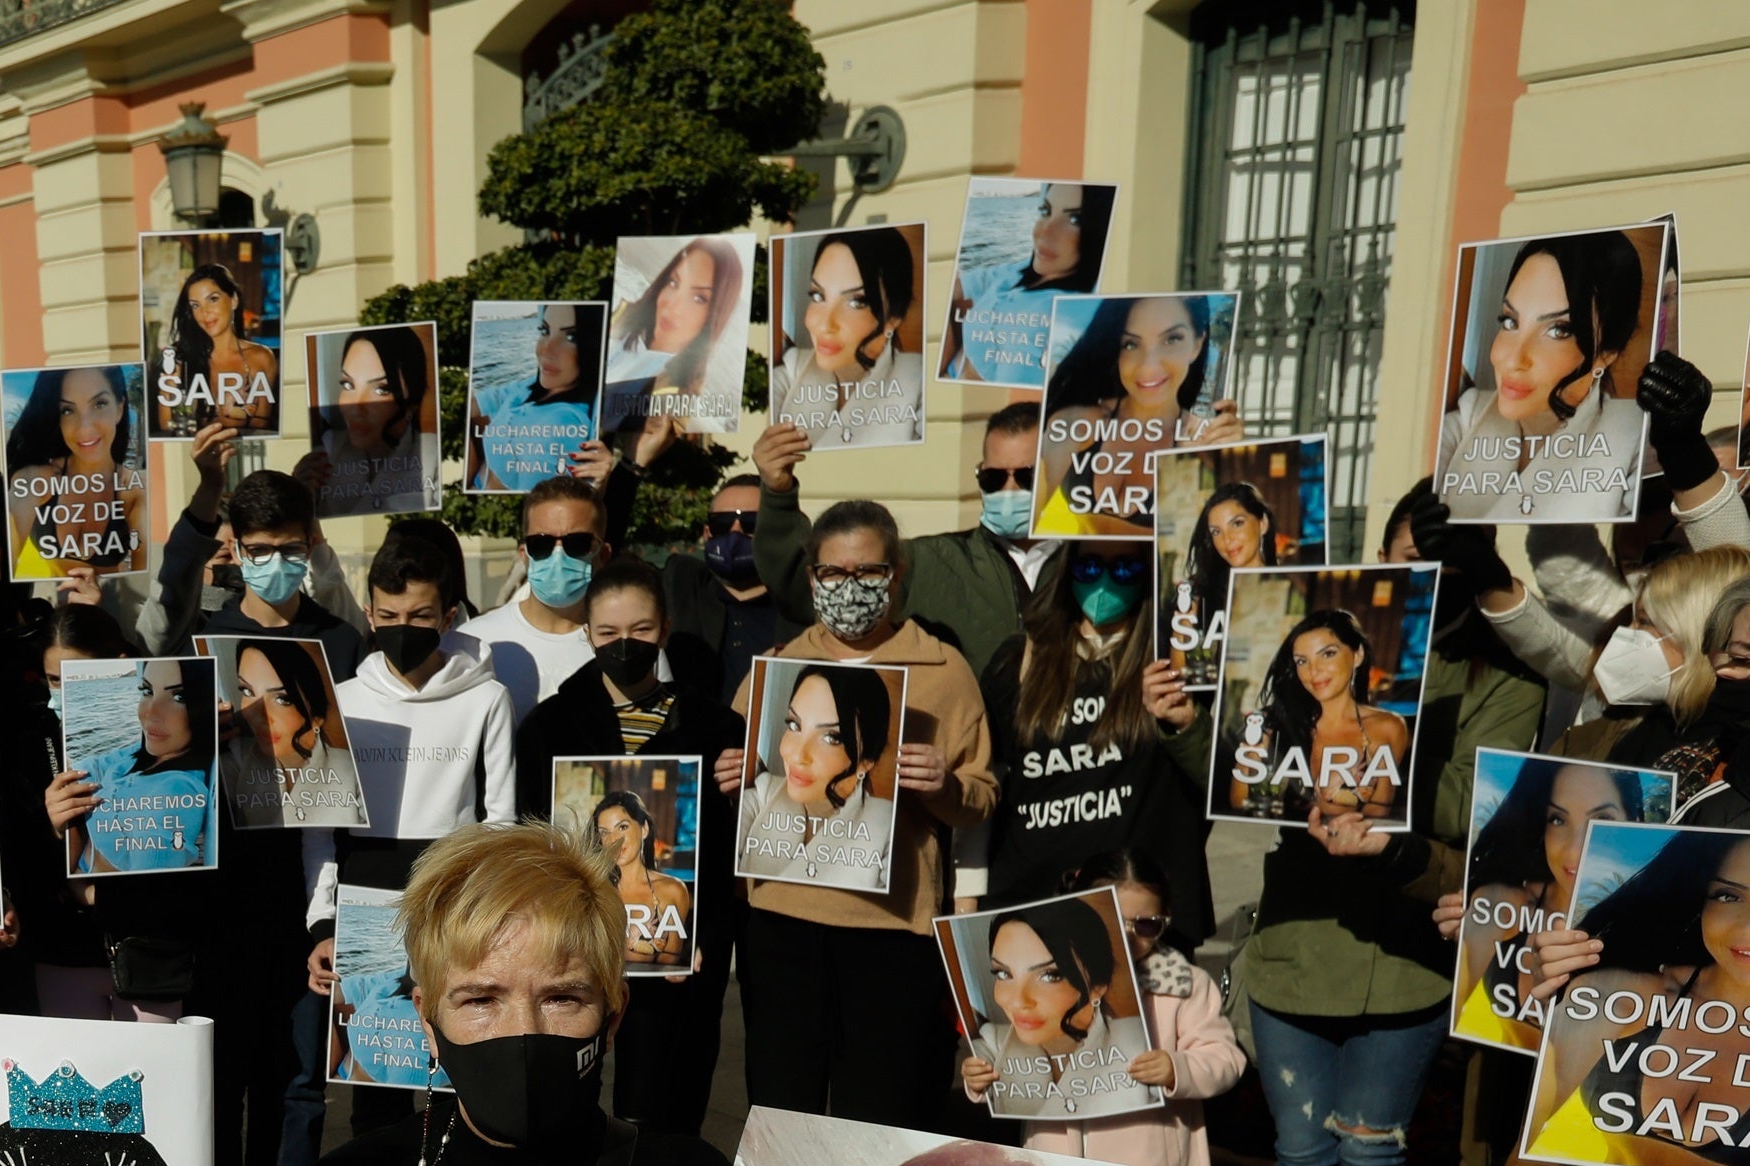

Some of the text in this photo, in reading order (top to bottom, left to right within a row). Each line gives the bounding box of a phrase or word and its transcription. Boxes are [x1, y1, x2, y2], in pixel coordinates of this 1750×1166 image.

[954, 308, 1050, 327] LUCHAREM
[971, 330, 1030, 347] HASTA
[984, 350, 1034, 367] FINAL
[156, 370, 277, 408] SARA
[793, 379, 903, 405] JUSTICIA
[665, 394, 698, 417] PARA
[699, 393, 734, 417] SARA
[850, 404, 919, 427] SARA
[474, 424, 589, 440] LUCHAREMOS
[1048, 419, 1164, 442] SOMOS
[491, 442, 568, 456] HASTA EL
[1463, 433, 1612, 462] JUSTICIA
[332, 456, 423, 477] JUSTICIA
[505, 460, 552, 474] FINAL
[1070, 452, 1133, 475] VOZ
[12, 468, 145, 499] SOMOS LA
[320, 477, 436, 500] PARA SARA
[1442, 468, 1630, 496] PARA SARA
[1068, 485, 1155, 515] SAR
[34, 500, 126, 526] VOZ DE
[37, 530, 125, 561] SARA
[1169, 610, 1225, 652] SA
[354, 747, 386, 763] ALVIN
[1022, 739, 1123, 779] SARA
[1231, 744, 1402, 788] SARA
[246, 767, 343, 785] JUSTICIA
[236, 790, 362, 809] PARA SARA
[96, 815, 185, 833] HASTA EL
[761, 811, 872, 842] JUSTICIA
[115, 836, 168, 852] FINAL
[745, 836, 884, 870] PARA SARA
[626, 905, 688, 941] RA
[1472, 897, 1565, 934] SOMO
[1494, 940, 1533, 975] VO
[1491, 983, 1546, 1028] SA
[338, 1012, 423, 1033] LUCHARE
[357, 1033, 430, 1052] HASTA E
[373, 1052, 424, 1069] FINAL
[1002, 1045, 1127, 1076] JUSTICIA
[1602, 1038, 1719, 1083] VOZ
[992, 1080, 1065, 1100] PARA
[1592, 1091, 1750, 1149] SAR
